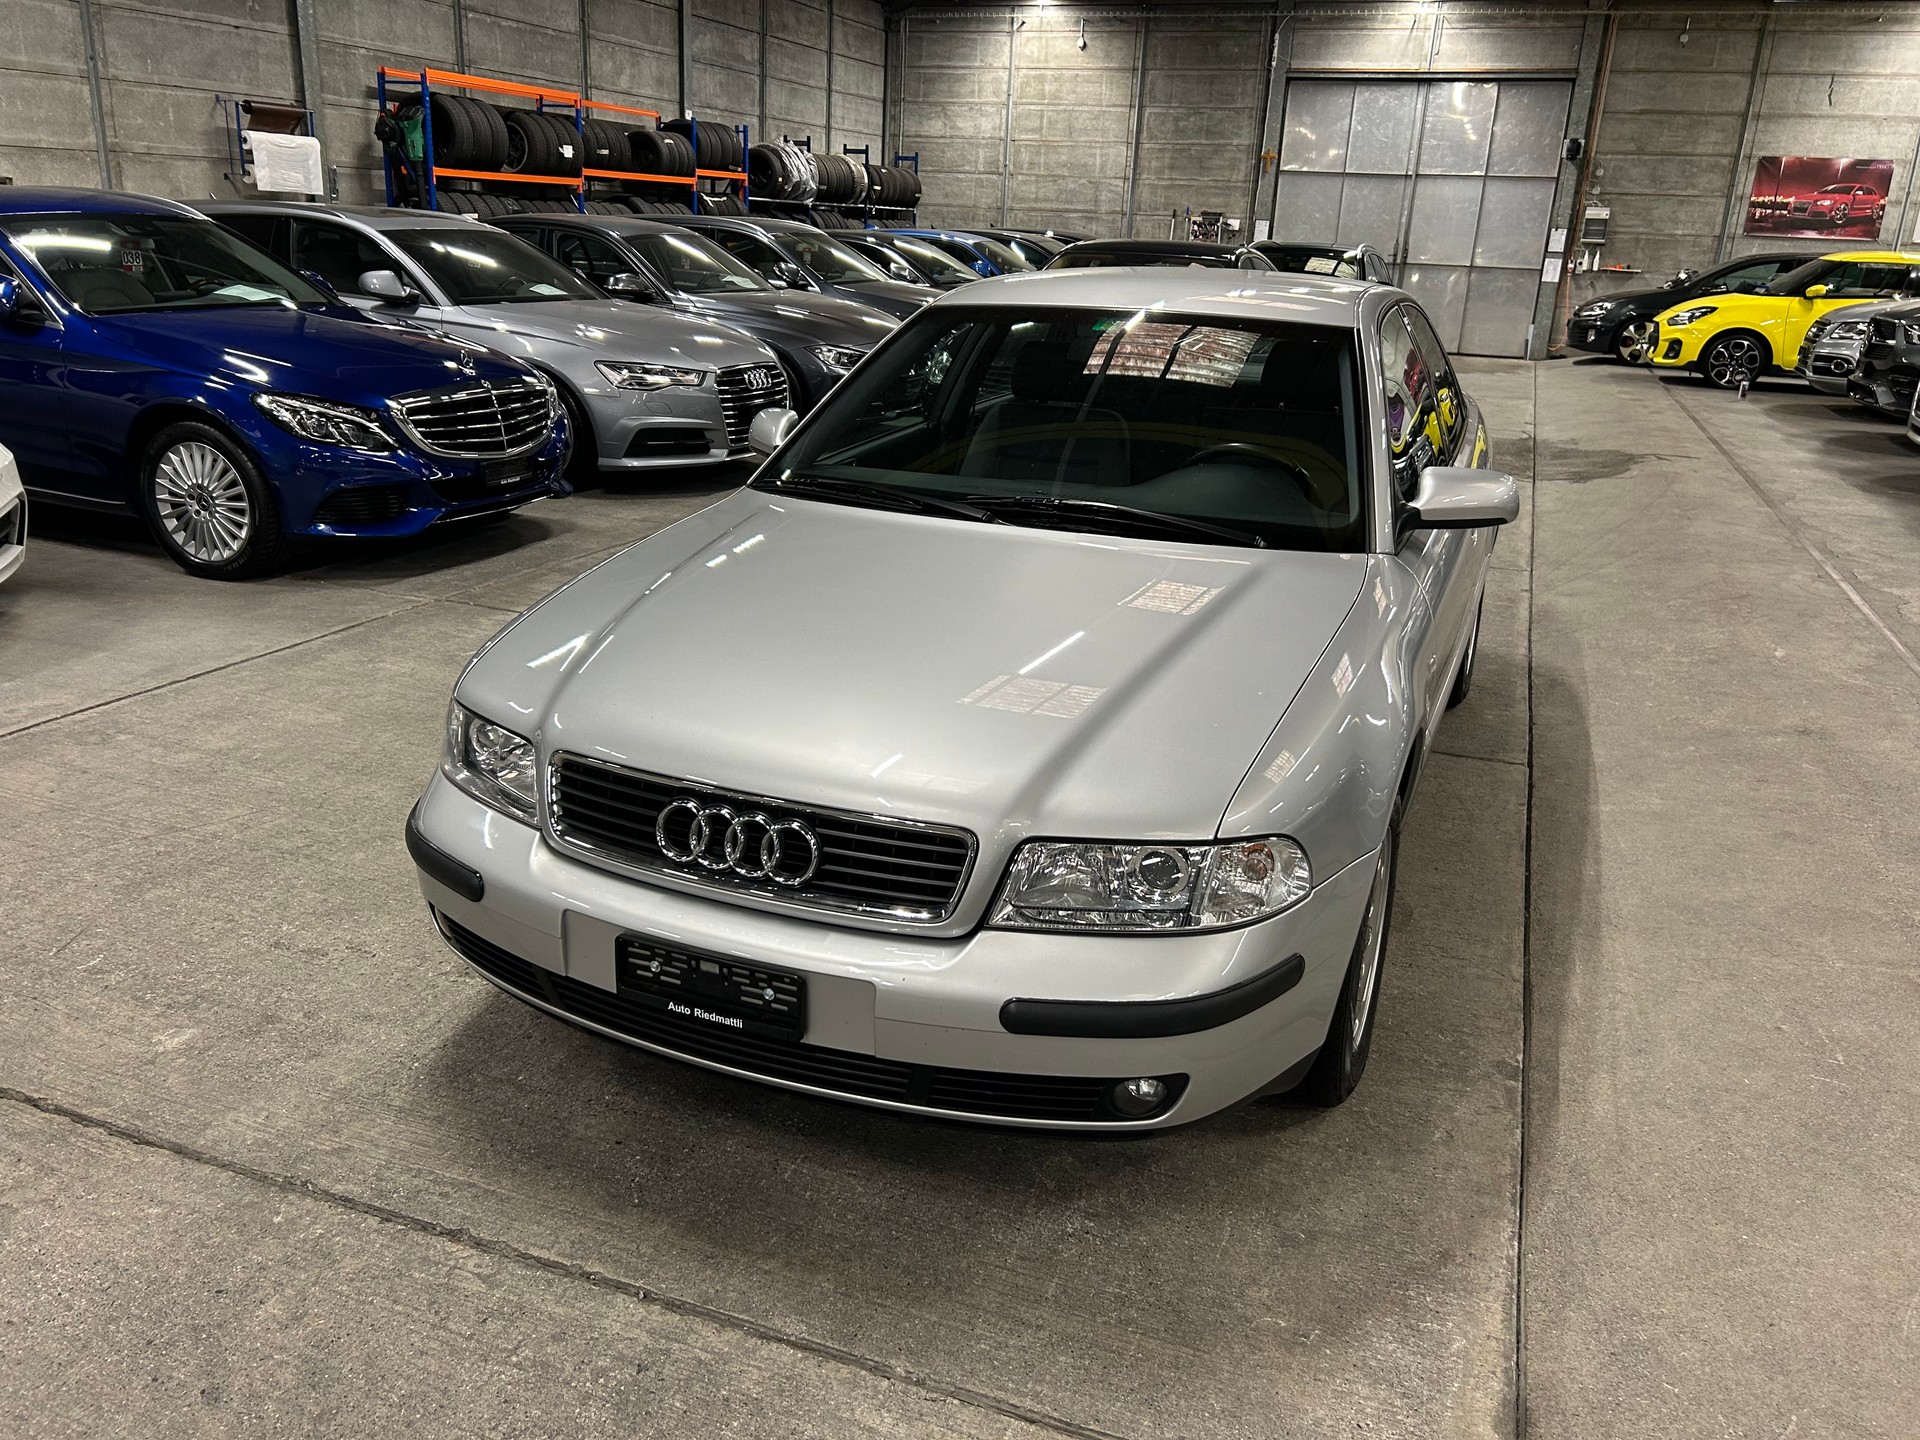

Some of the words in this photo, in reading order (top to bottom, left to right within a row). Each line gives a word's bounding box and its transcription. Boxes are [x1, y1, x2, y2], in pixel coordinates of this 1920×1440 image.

[122, 251, 141, 265] 038
[668, 1001, 691, 1015] Auto
[694, 1007, 743, 1029] Riedmattli
